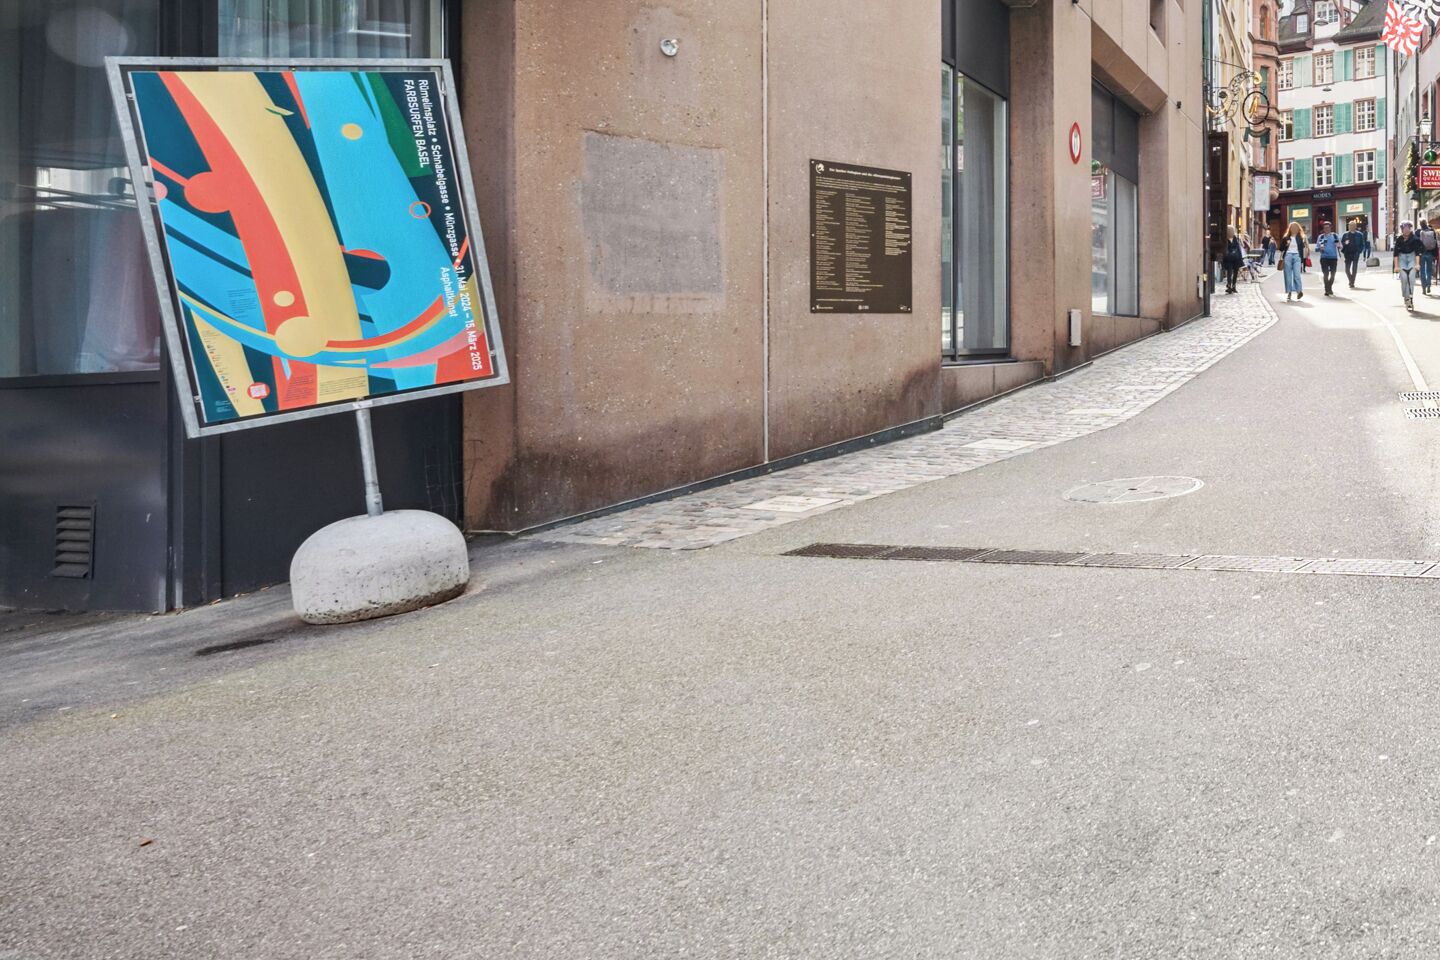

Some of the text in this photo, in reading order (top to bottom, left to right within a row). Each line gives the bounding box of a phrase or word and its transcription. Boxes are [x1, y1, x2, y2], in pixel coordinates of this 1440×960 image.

[419, 79, 436, 136] Rümelinsplatz
[404, 79, 429, 167] FARBSURFEN BASEL
[431, 144, 449, 204] Schnabelgasse
[444, 212, 461, 257] Münzgasse
[455, 265, 464, 276] 31.
[440, 266, 458, 317] Asphaltkunst
[458, 277, 467, 291] Mai
[460, 293, 471, 311] 2024
[465, 319, 475, 330] 15.
[467, 330, 479, 350] März
[471, 352, 482, 370] 2025
